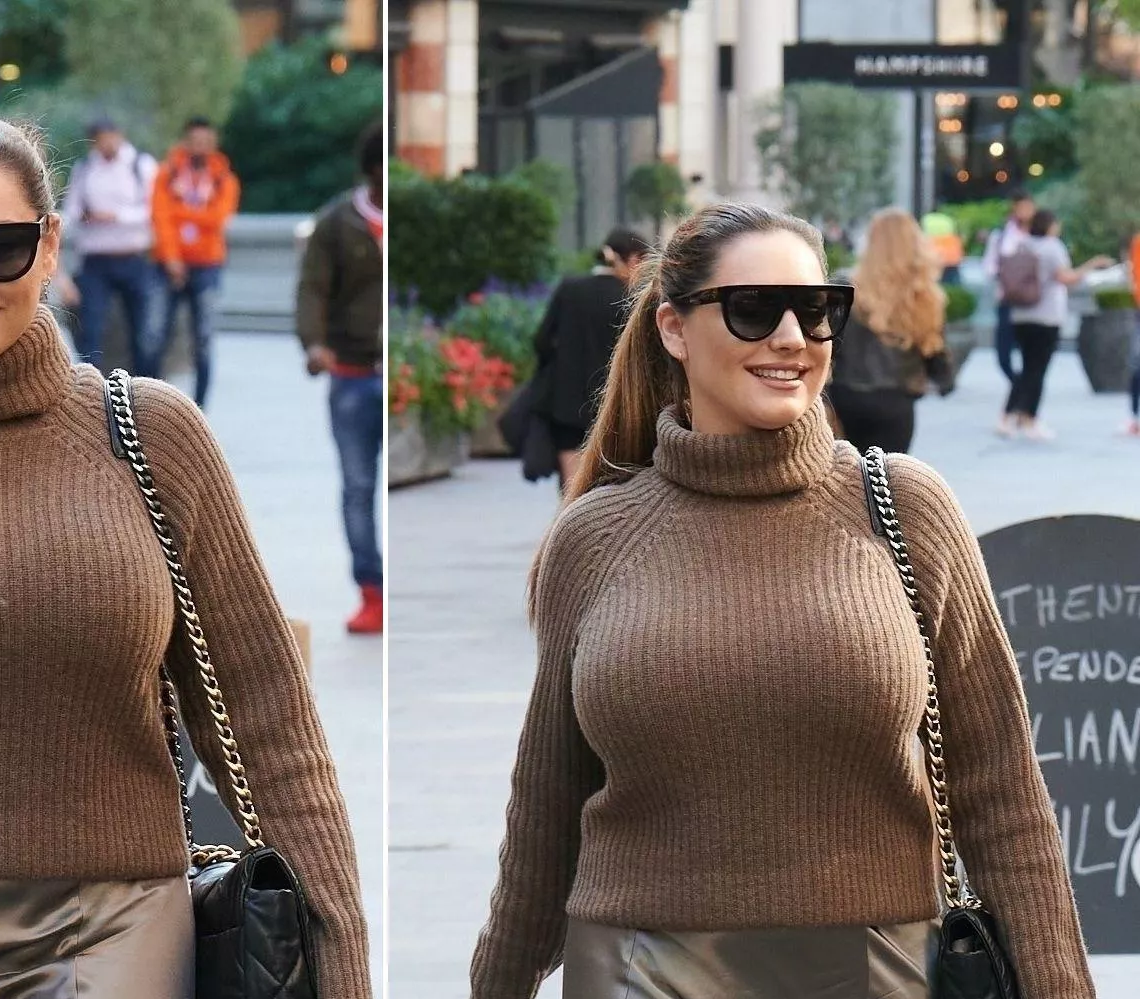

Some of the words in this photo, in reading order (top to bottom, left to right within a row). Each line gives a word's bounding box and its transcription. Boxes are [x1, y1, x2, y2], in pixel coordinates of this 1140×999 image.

[855, 55, 988, 76] HAMPSHIRE
[999, 583, 1140, 628] THENT
[1052, 799, 1140, 897] ILY
